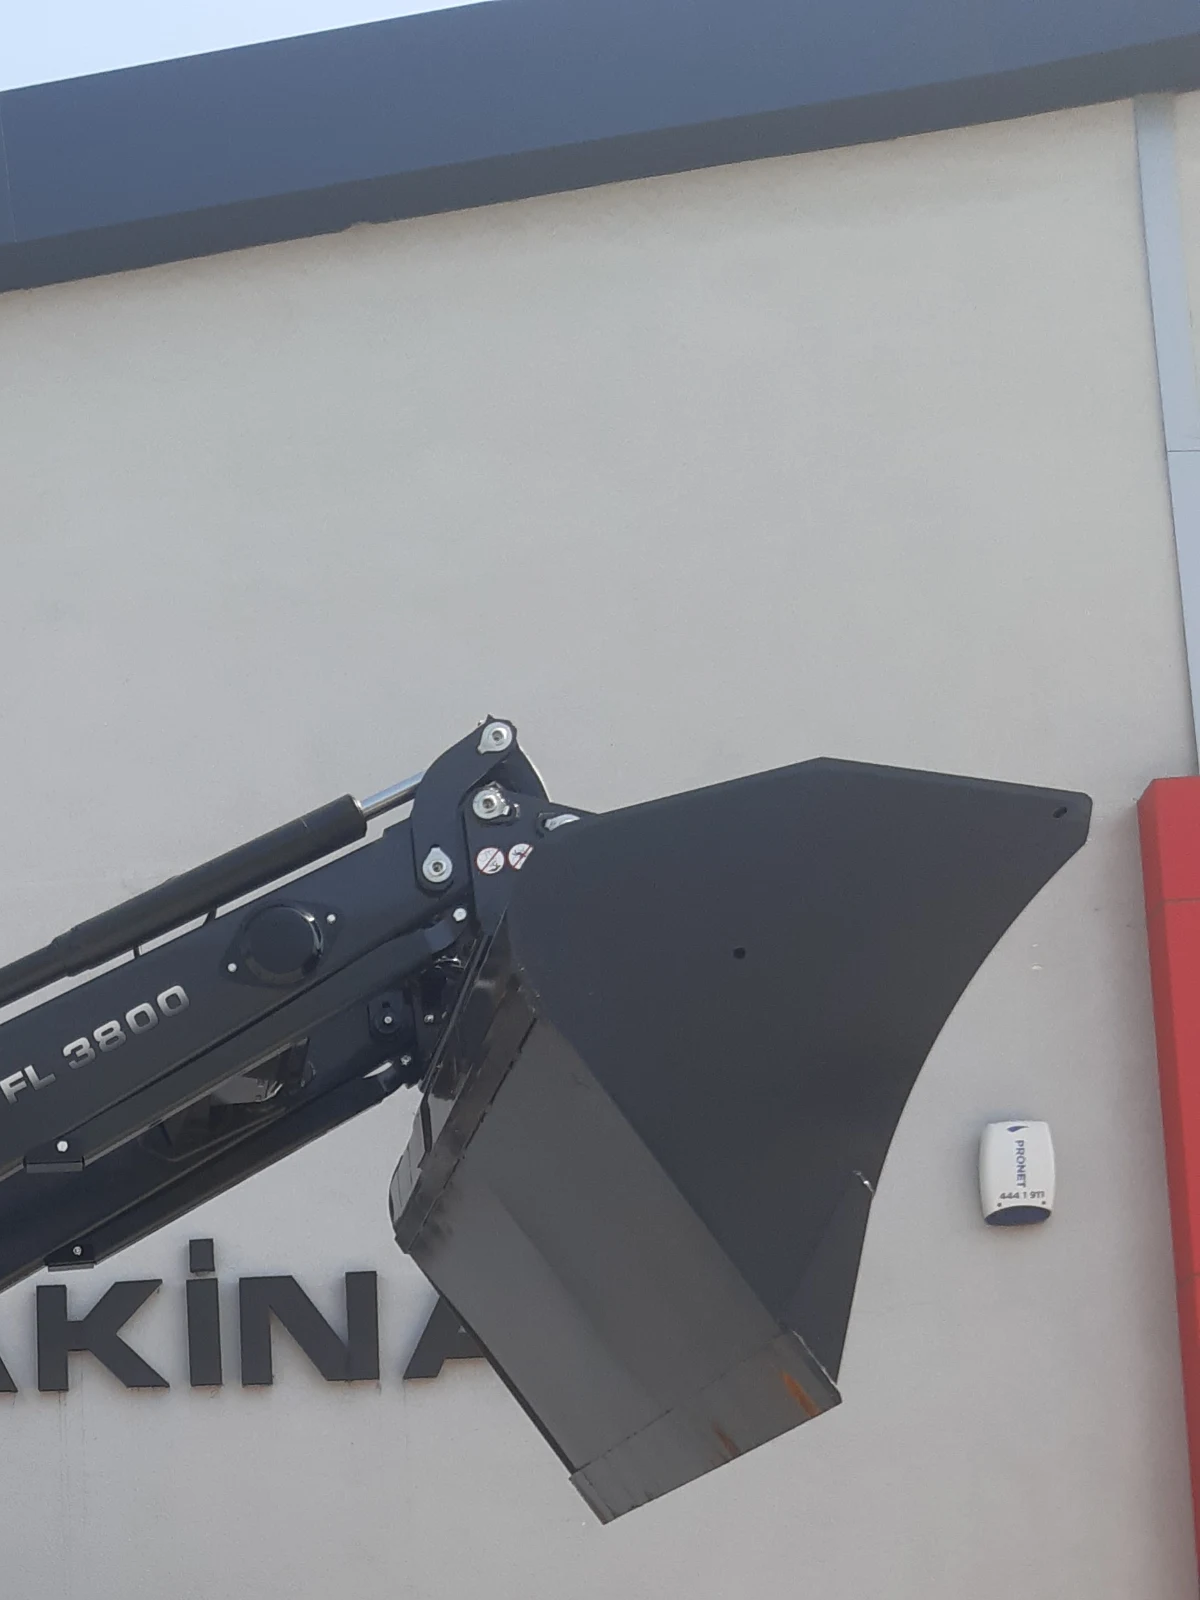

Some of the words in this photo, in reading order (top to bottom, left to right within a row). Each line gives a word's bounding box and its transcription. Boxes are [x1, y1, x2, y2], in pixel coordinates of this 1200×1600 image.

[62, 985, 190, 1070] 3800
[1015, 1139, 1027, 1188] PRONET
[999, 1191, 1020, 1200] 444
